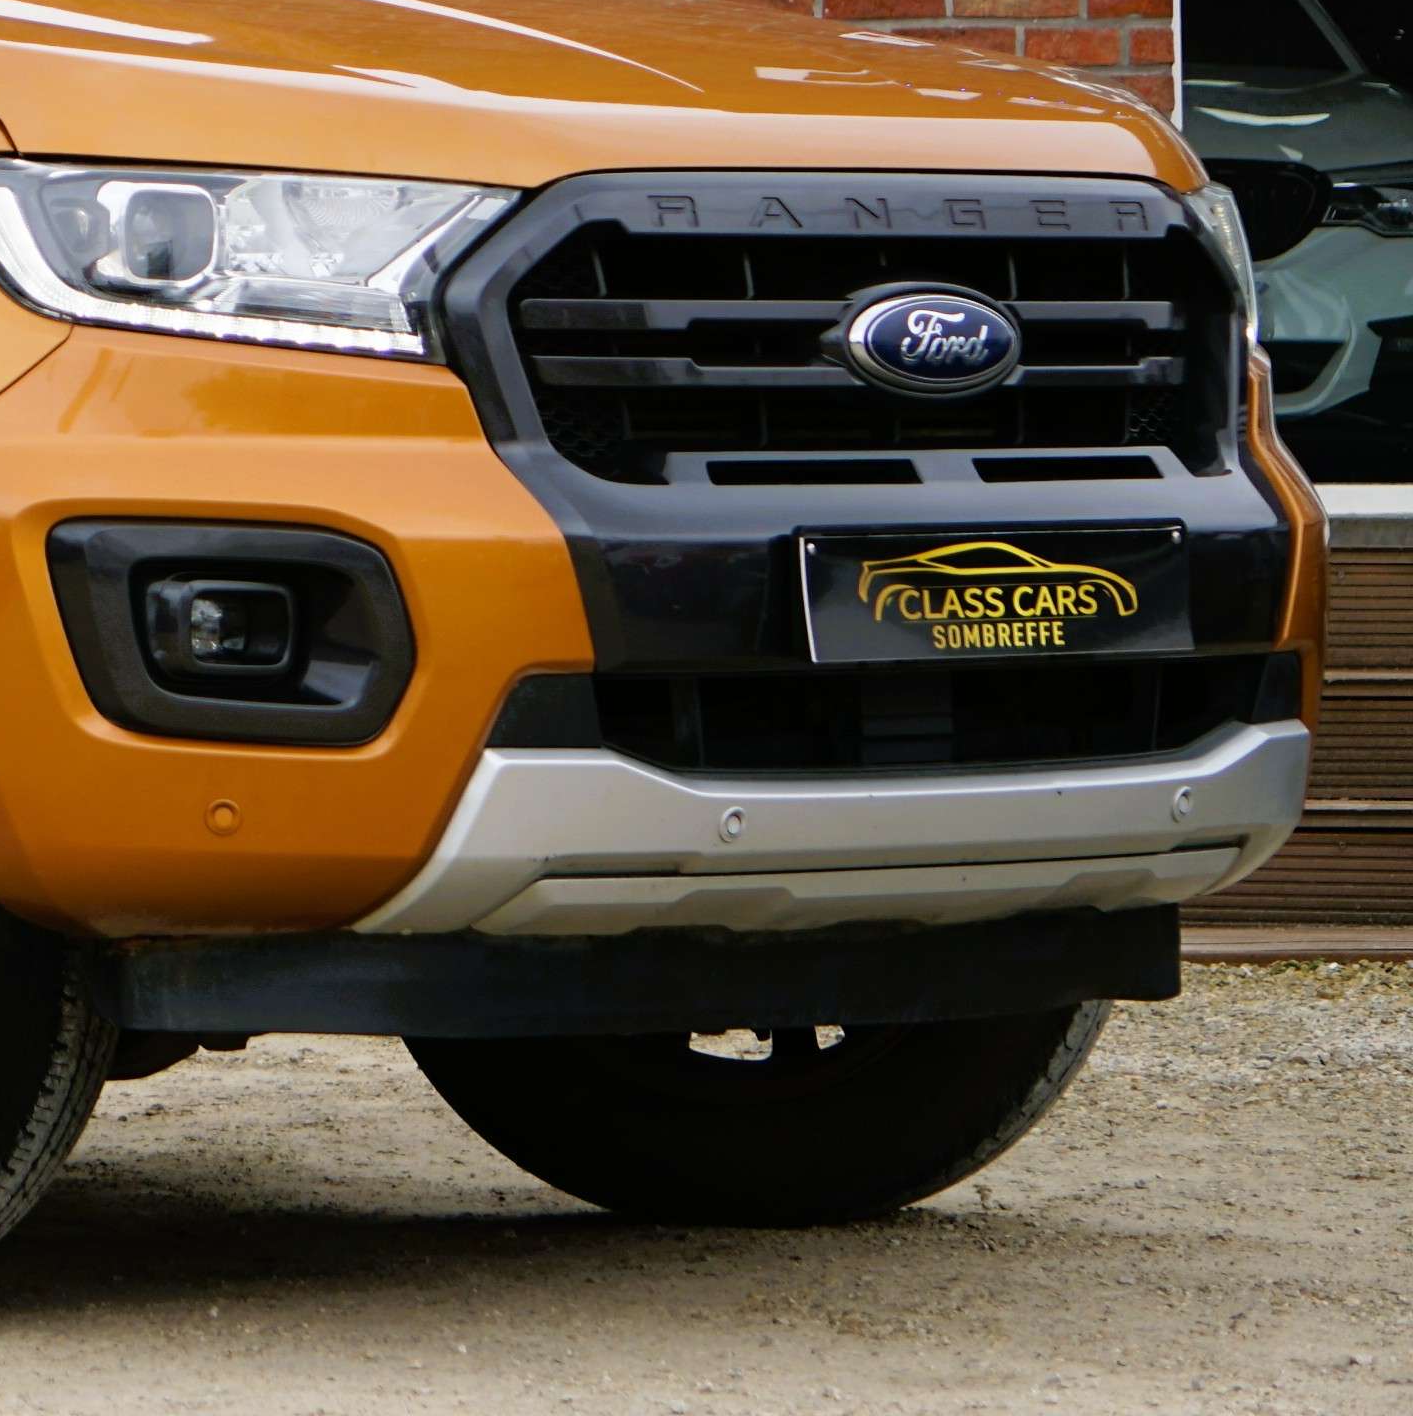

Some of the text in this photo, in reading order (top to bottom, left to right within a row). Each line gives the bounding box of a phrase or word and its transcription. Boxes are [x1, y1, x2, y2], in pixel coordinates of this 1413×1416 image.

[646, 194, 1151, 233] RANGER
[899, 308, 990, 363] Ford
[899, 584, 1098, 620] CLASS CARS
[932, 621, 1066, 650] SOMBREFFE
